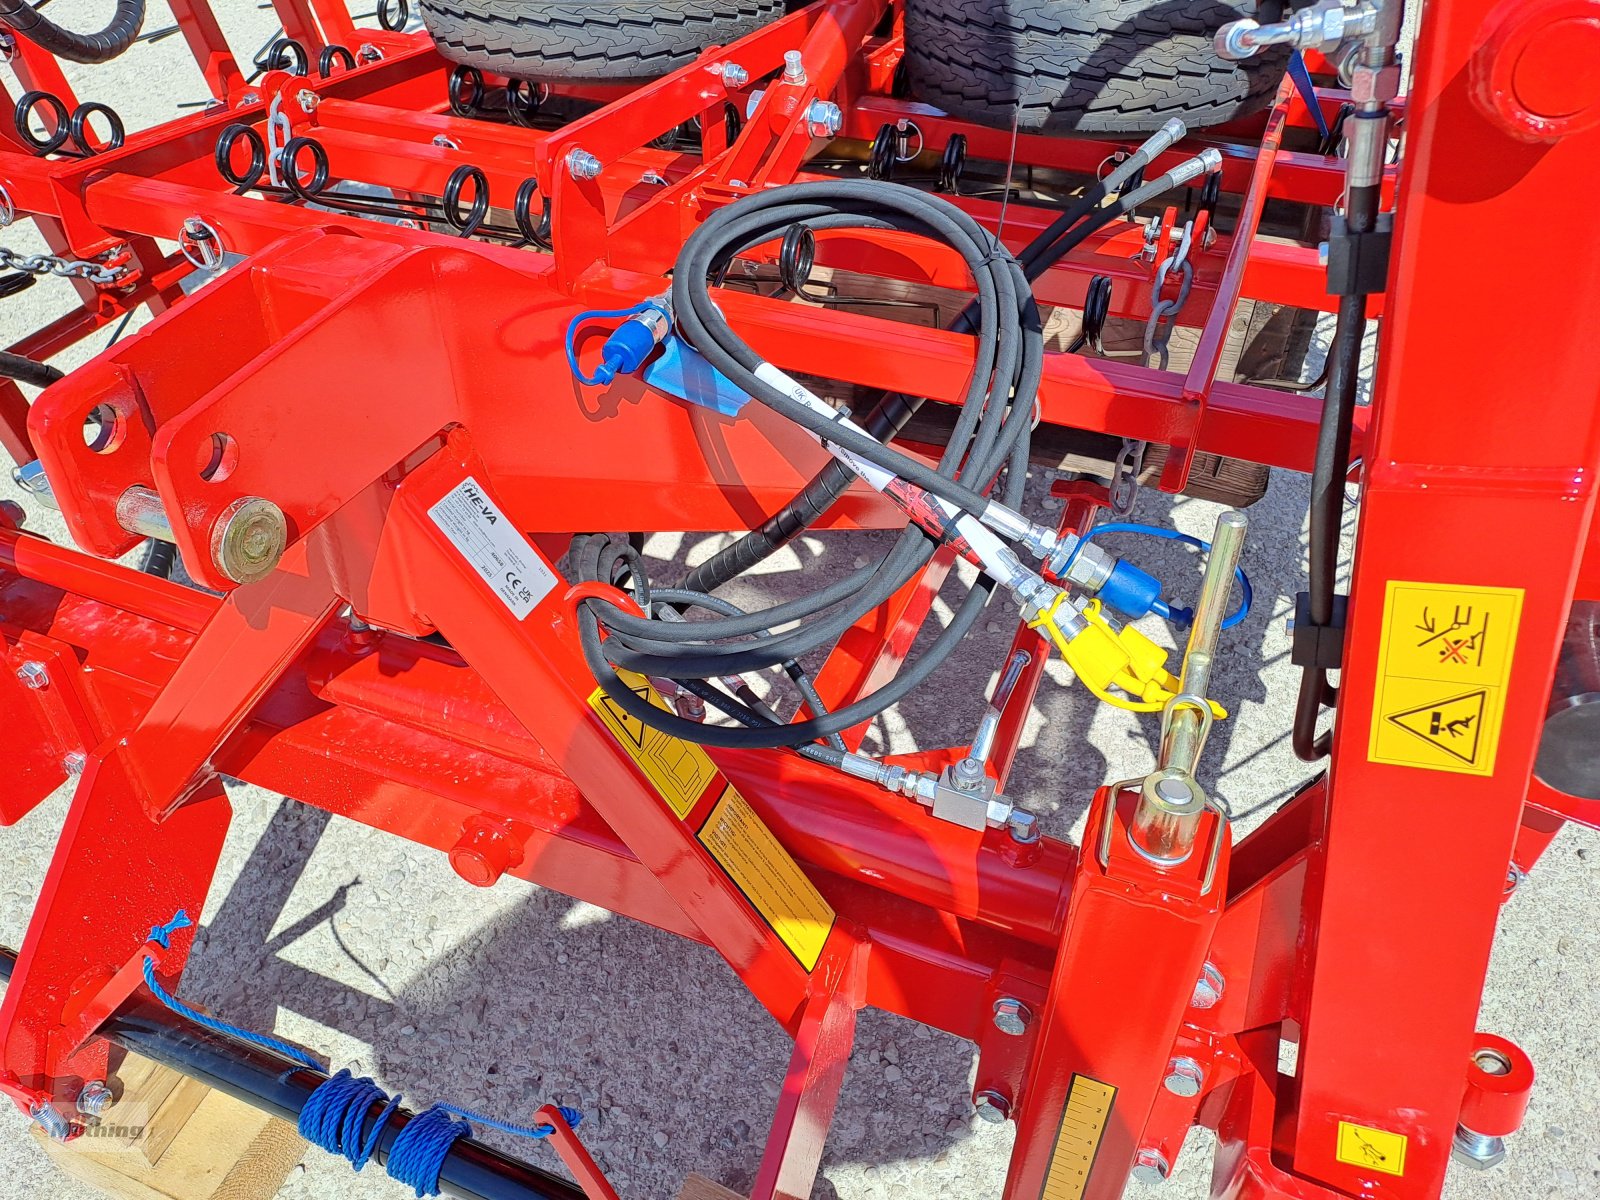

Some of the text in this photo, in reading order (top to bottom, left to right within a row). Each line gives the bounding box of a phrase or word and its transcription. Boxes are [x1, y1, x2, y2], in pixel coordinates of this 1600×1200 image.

[794, 388, 805, 400] UK
[464, 488, 497, 525] HE-VA
[506, 572, 521, 589] CE
[523, 586, 533, 598] UK
